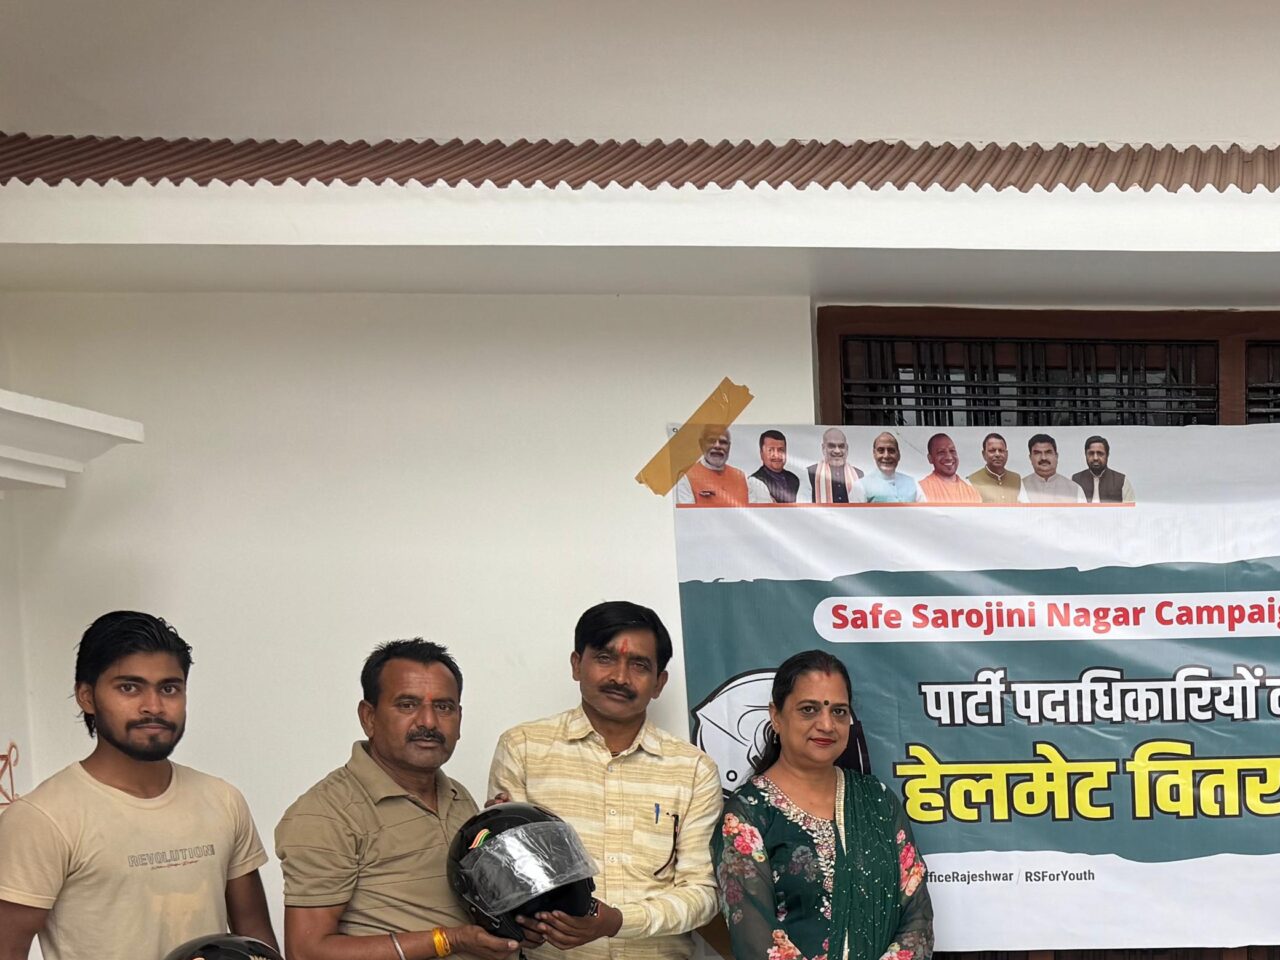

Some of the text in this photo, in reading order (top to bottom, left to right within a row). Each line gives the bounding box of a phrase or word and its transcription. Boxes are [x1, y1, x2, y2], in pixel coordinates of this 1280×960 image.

[831, 602, 902, 630] Safe
[912, 601, 1036, 636] Sarojini
[1047, 602, 1146, 634] Nagar
[919, 668, 1006, 725] पार्टी
[1009, 666, 1265, 724] पदाधिकारियों
[897, 741, 1119, 823] हेलमेट
[1025, 870, 1095, 882] RSForYouth
